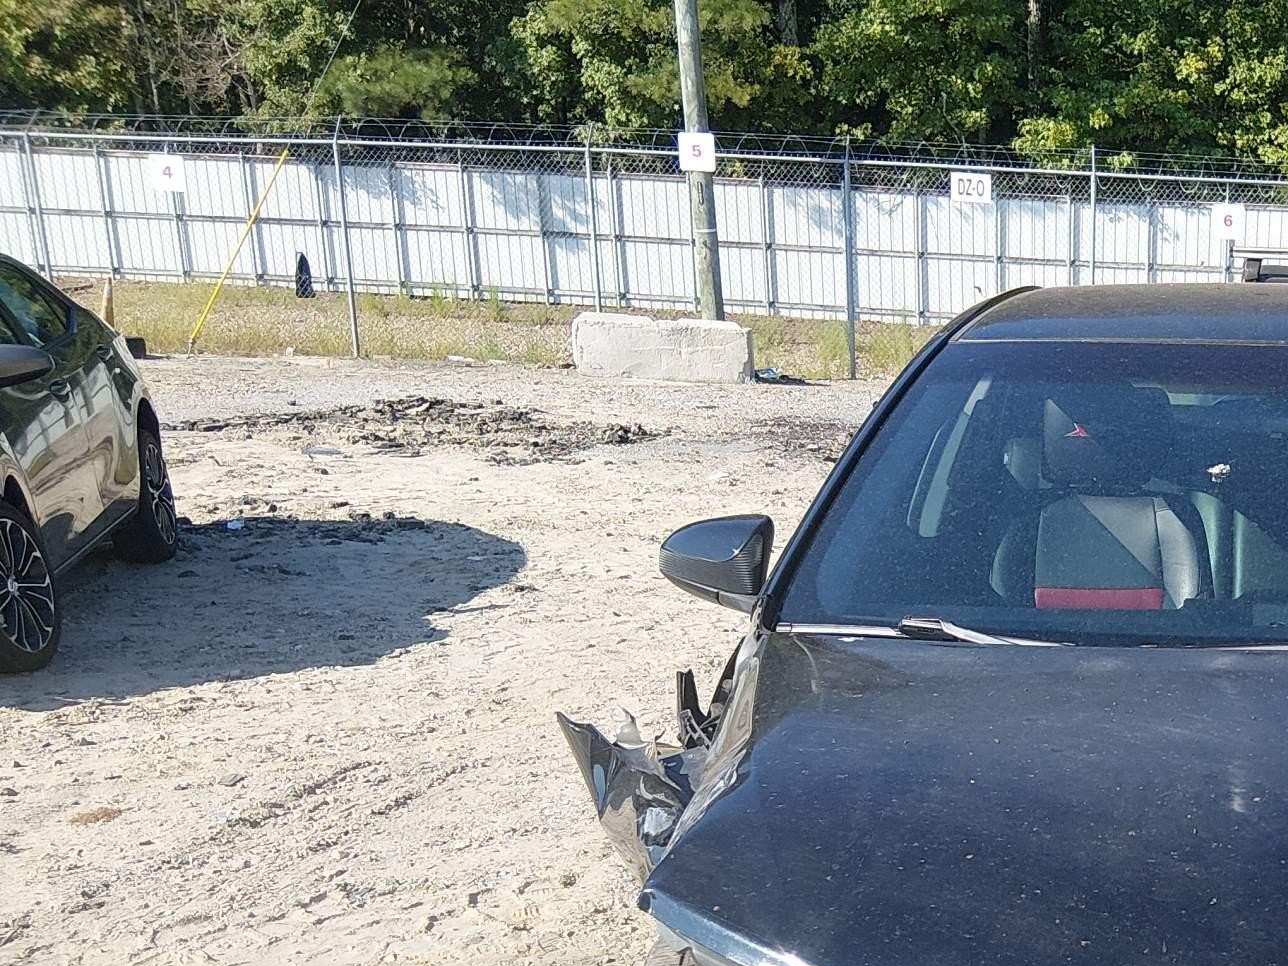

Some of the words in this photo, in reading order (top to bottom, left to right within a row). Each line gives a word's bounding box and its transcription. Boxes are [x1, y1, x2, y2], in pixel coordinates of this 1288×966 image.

[692, 144, 702, 157] 5
[162, 165, 173, 179] 4
[1223, 214, 1233, 227] 6
